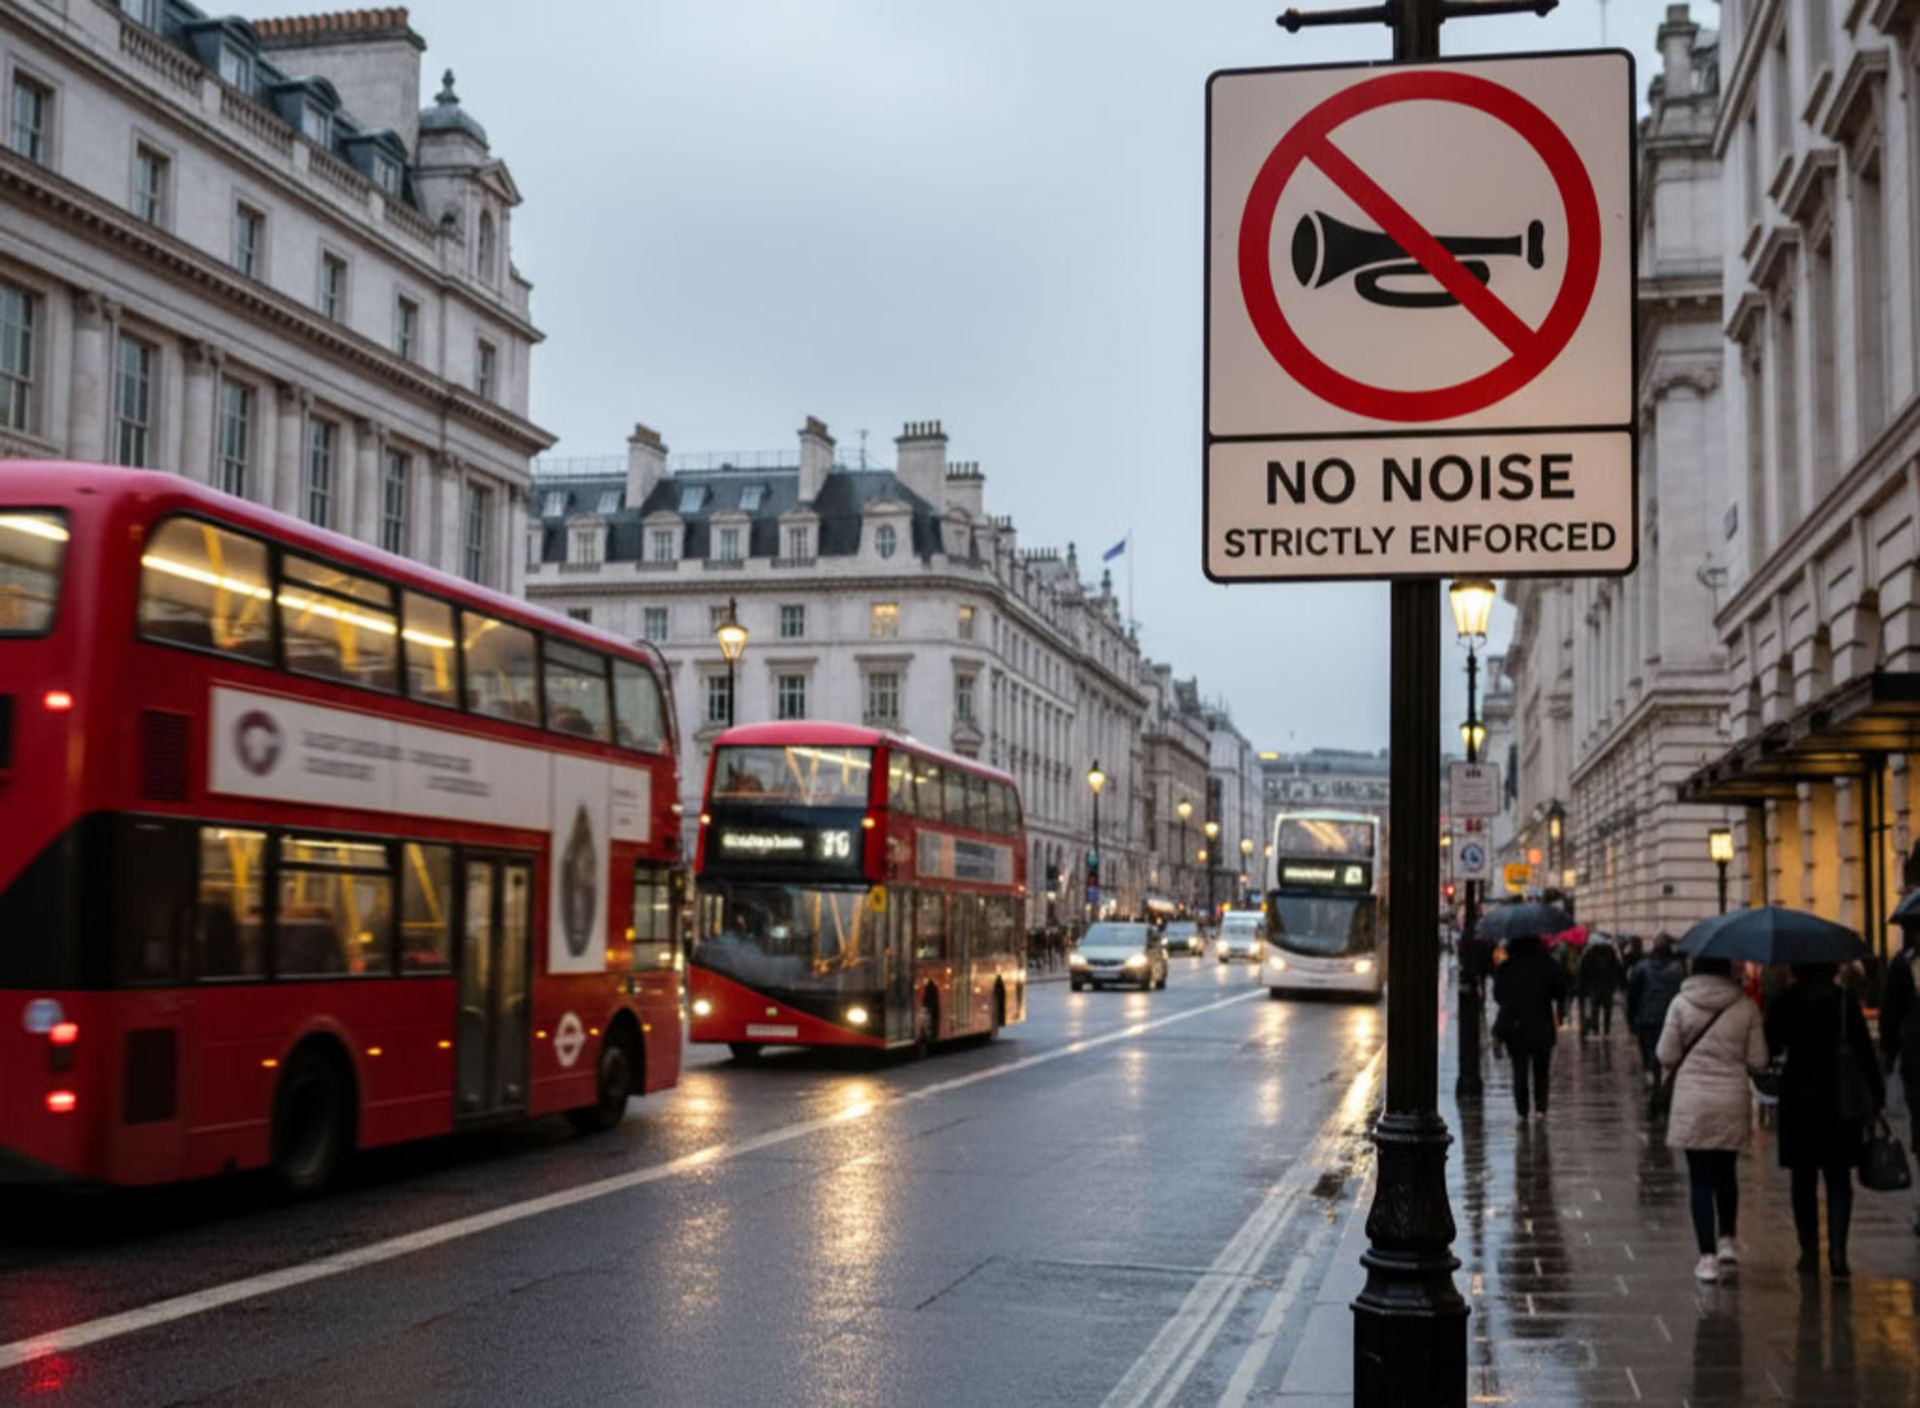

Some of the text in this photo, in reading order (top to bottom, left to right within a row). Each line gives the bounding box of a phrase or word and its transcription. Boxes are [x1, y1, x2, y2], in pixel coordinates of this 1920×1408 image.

[1266, 454, 1575, 505] NO NOISE
[1224, 522, 1617, 558] STRICTLY ENFORCED
